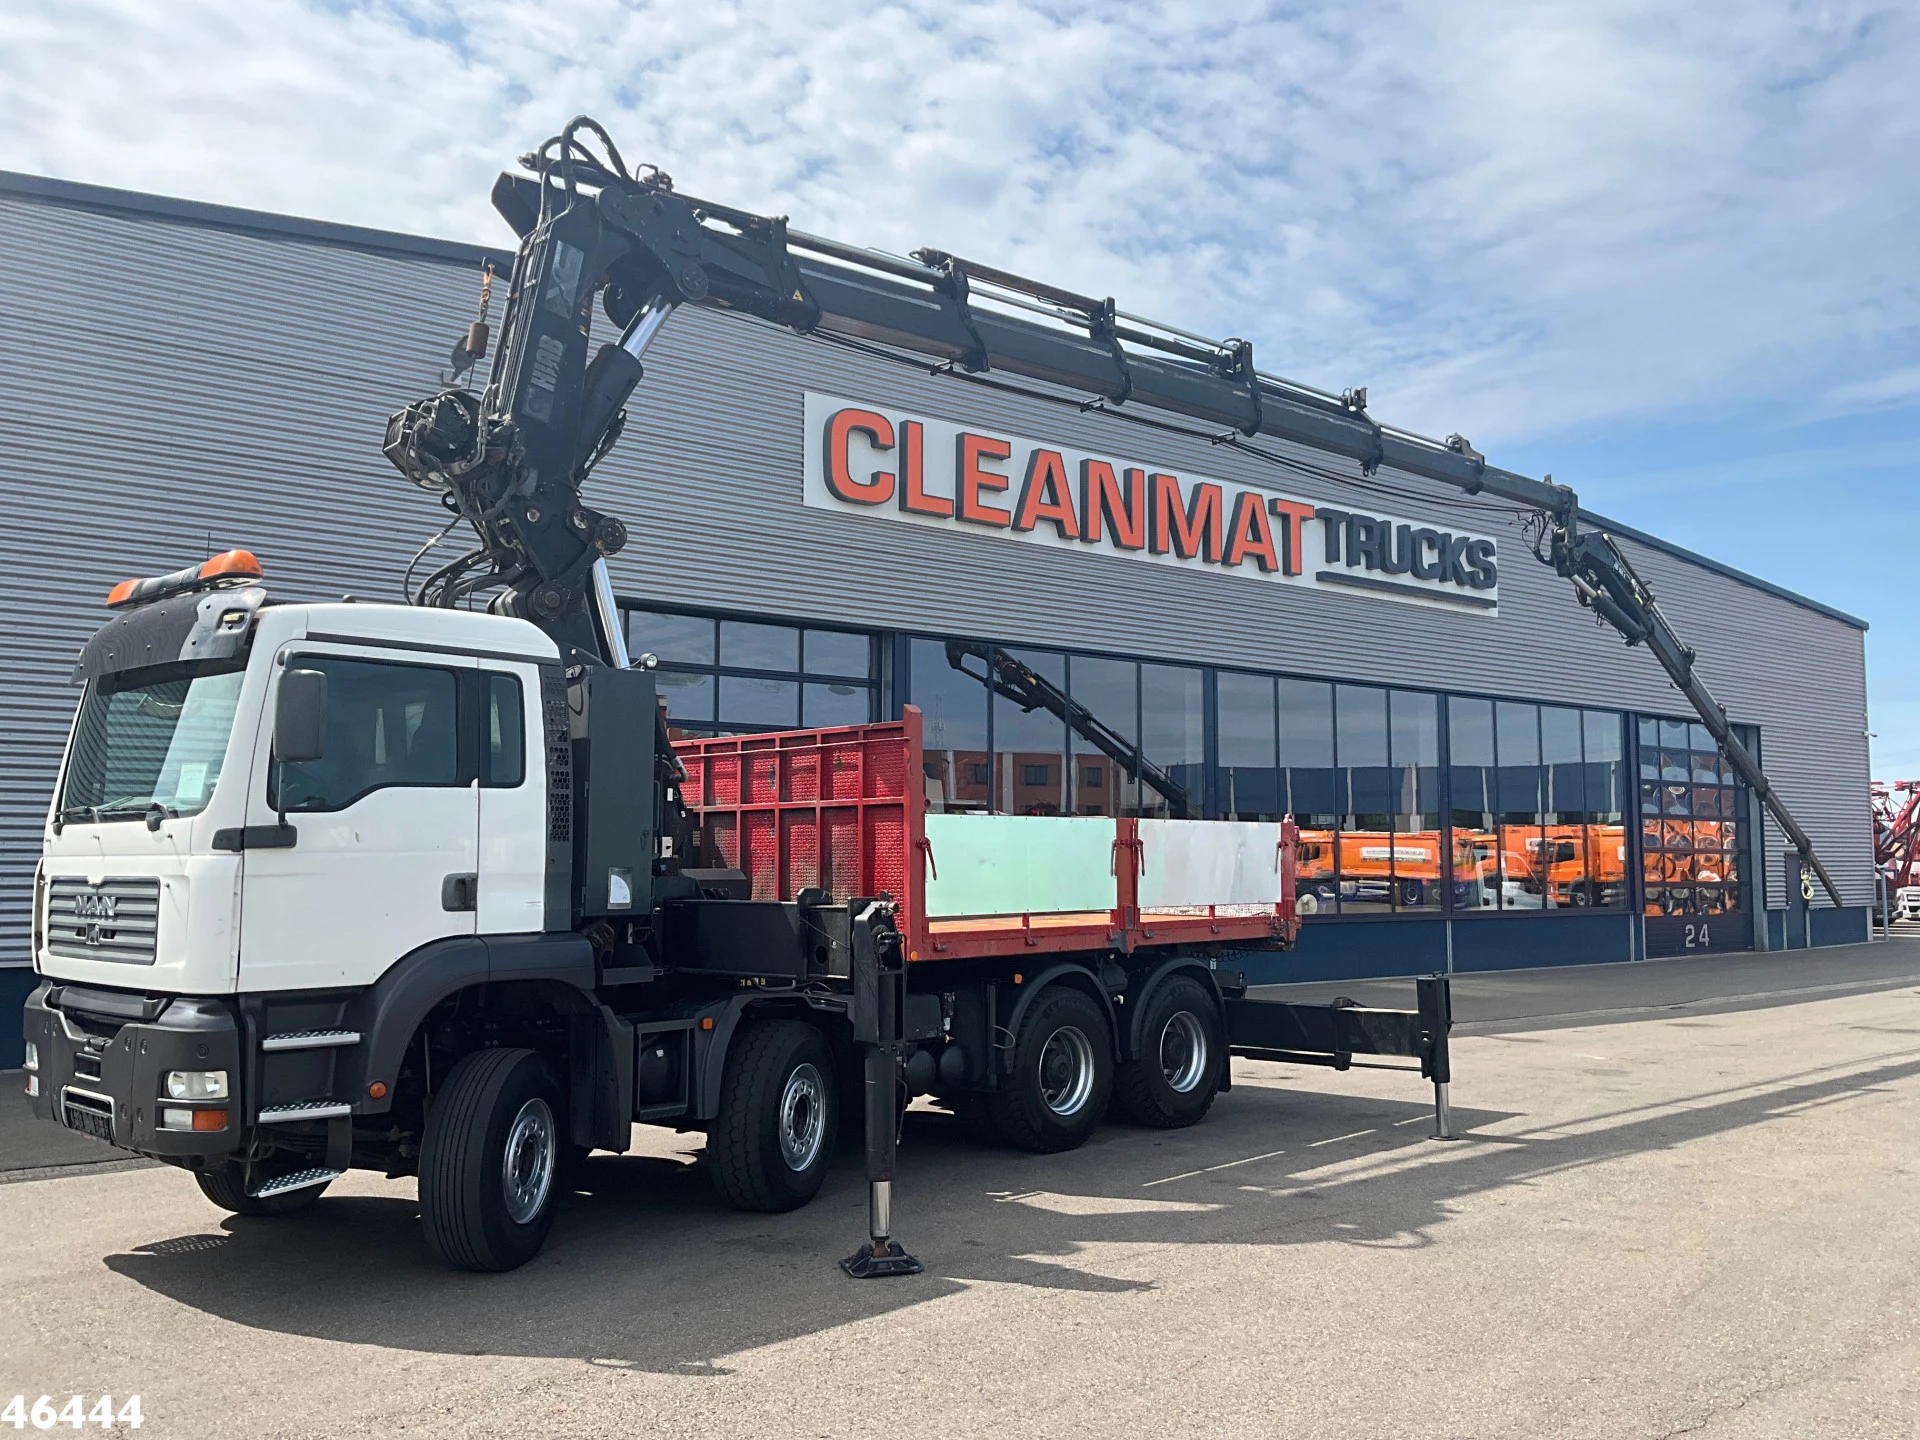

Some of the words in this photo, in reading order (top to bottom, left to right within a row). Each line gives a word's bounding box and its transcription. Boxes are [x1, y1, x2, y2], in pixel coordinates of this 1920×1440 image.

[531, 334, 564, 392] HIAB
[823, 408, 1314, 577] CLEANMAT
[1315, 507, 1498, 590] TRUCKS
[75, 895, 116, 917] MAN
[1685, 923, 1710, 948] 24
